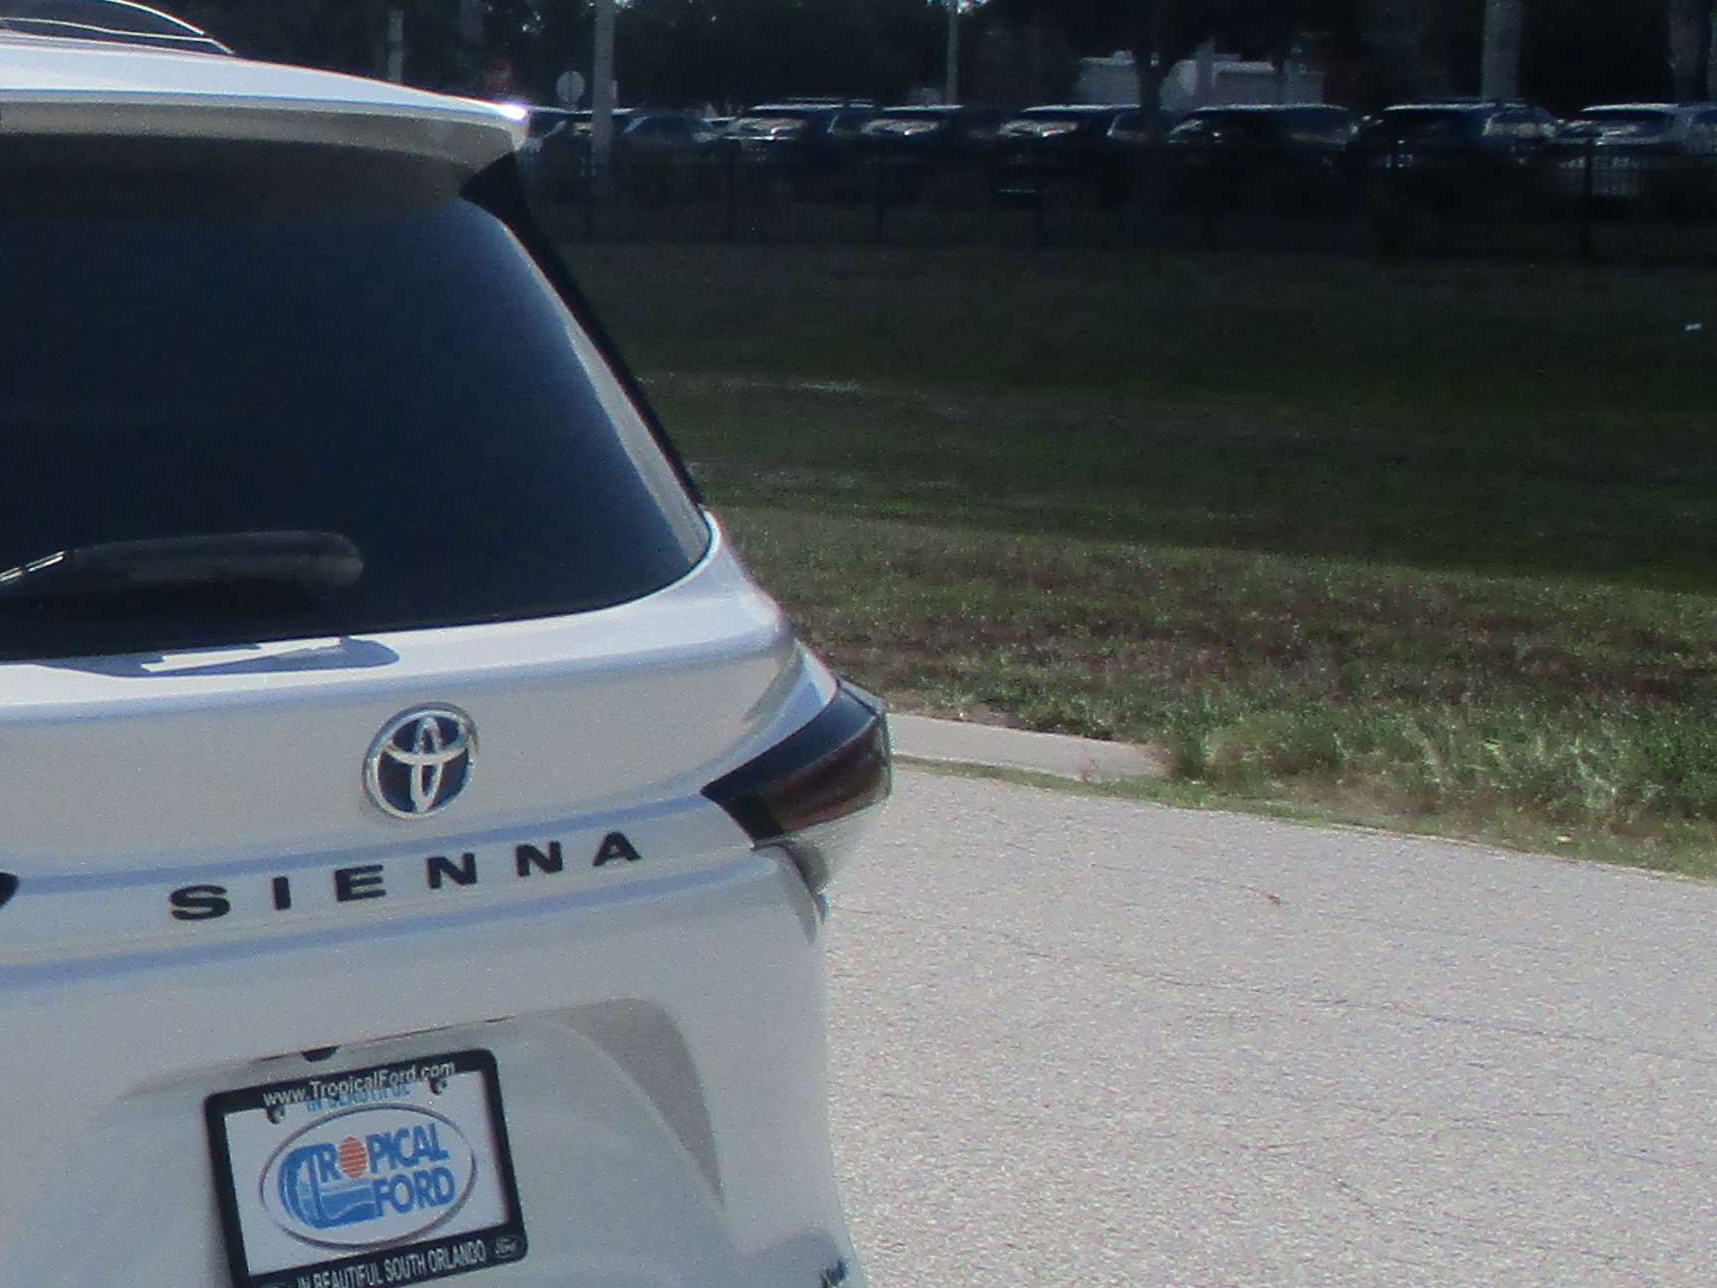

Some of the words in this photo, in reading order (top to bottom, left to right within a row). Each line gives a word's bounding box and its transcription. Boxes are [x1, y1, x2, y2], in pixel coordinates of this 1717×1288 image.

[168, 831, 642, 921] SIENNA
[262, 1061, 456, 1107] www.TropicalFord.com
[278, 1123, 450, 1218] TROPICAL
[373, 1167, 455, 1217] FORD
[384, 1254, 425, 1283] SOUTH
[428, 1239, 487, 1273] ORLANDO
